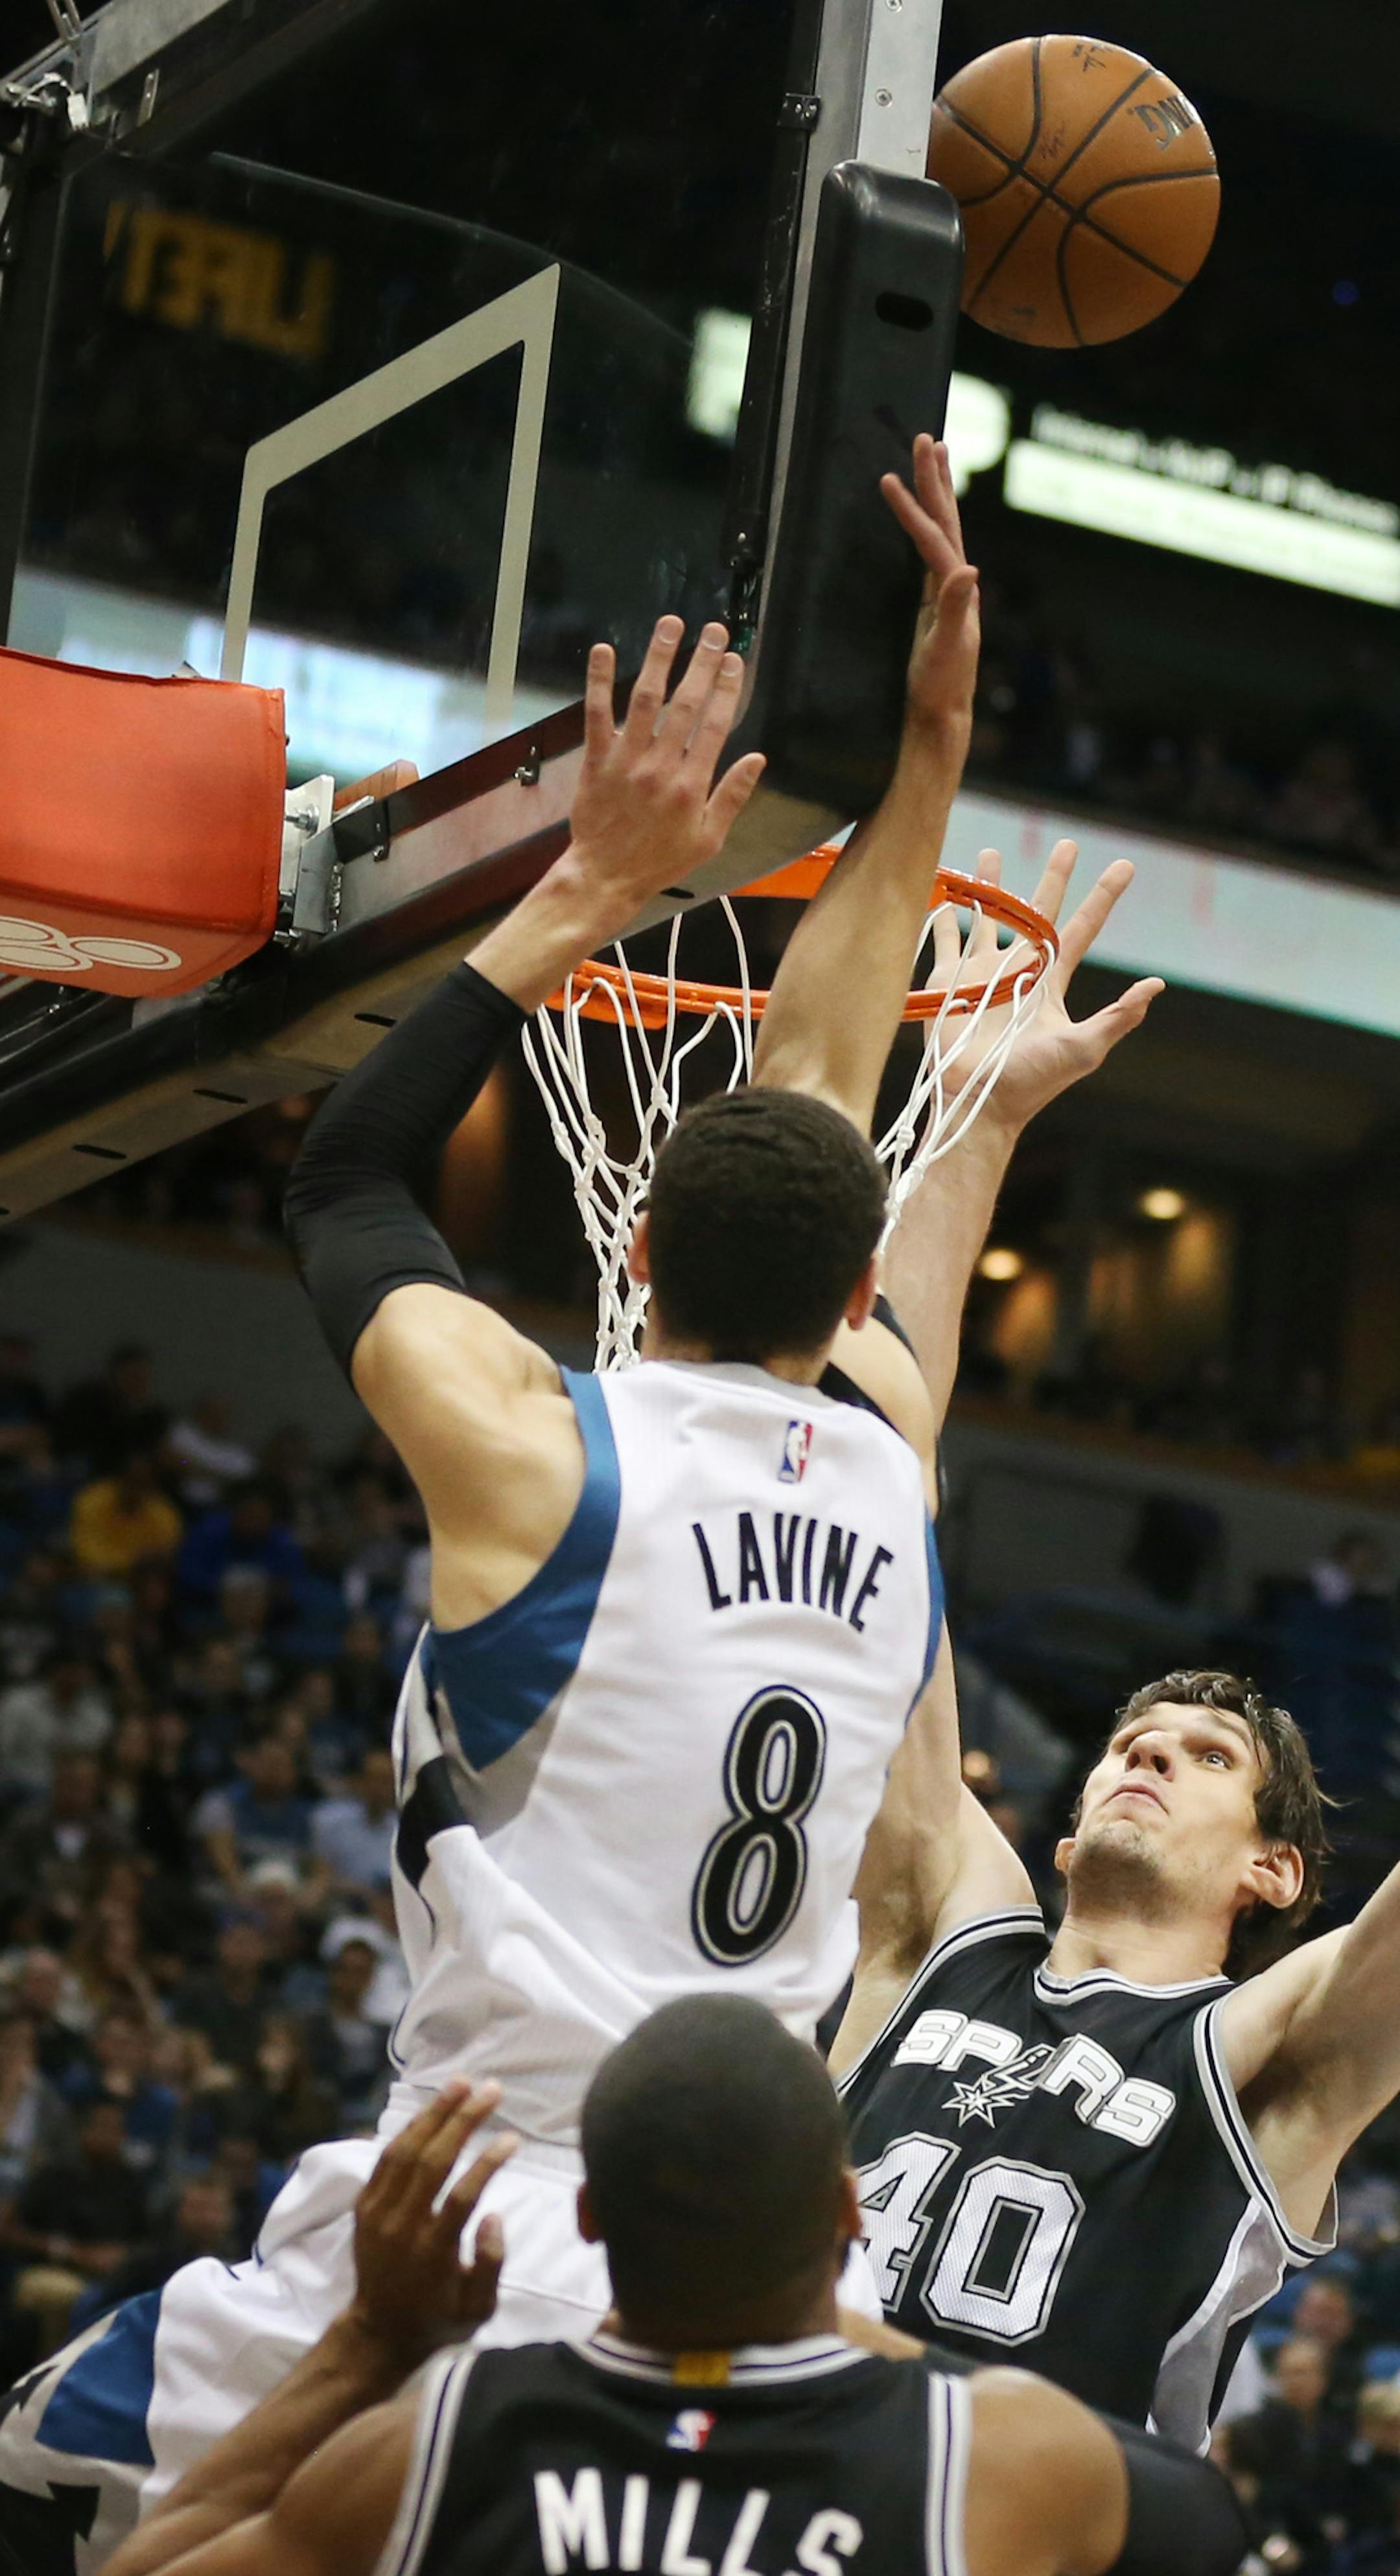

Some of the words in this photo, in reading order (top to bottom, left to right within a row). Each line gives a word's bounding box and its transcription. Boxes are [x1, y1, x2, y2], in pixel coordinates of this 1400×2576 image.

[692, 1512, 894, 1633] LAVINE
[691, 1684, 826, 1968] 8
[854, 2131, 1086, 2347] 40
[533, 2466, 864, 2576] MILLS
